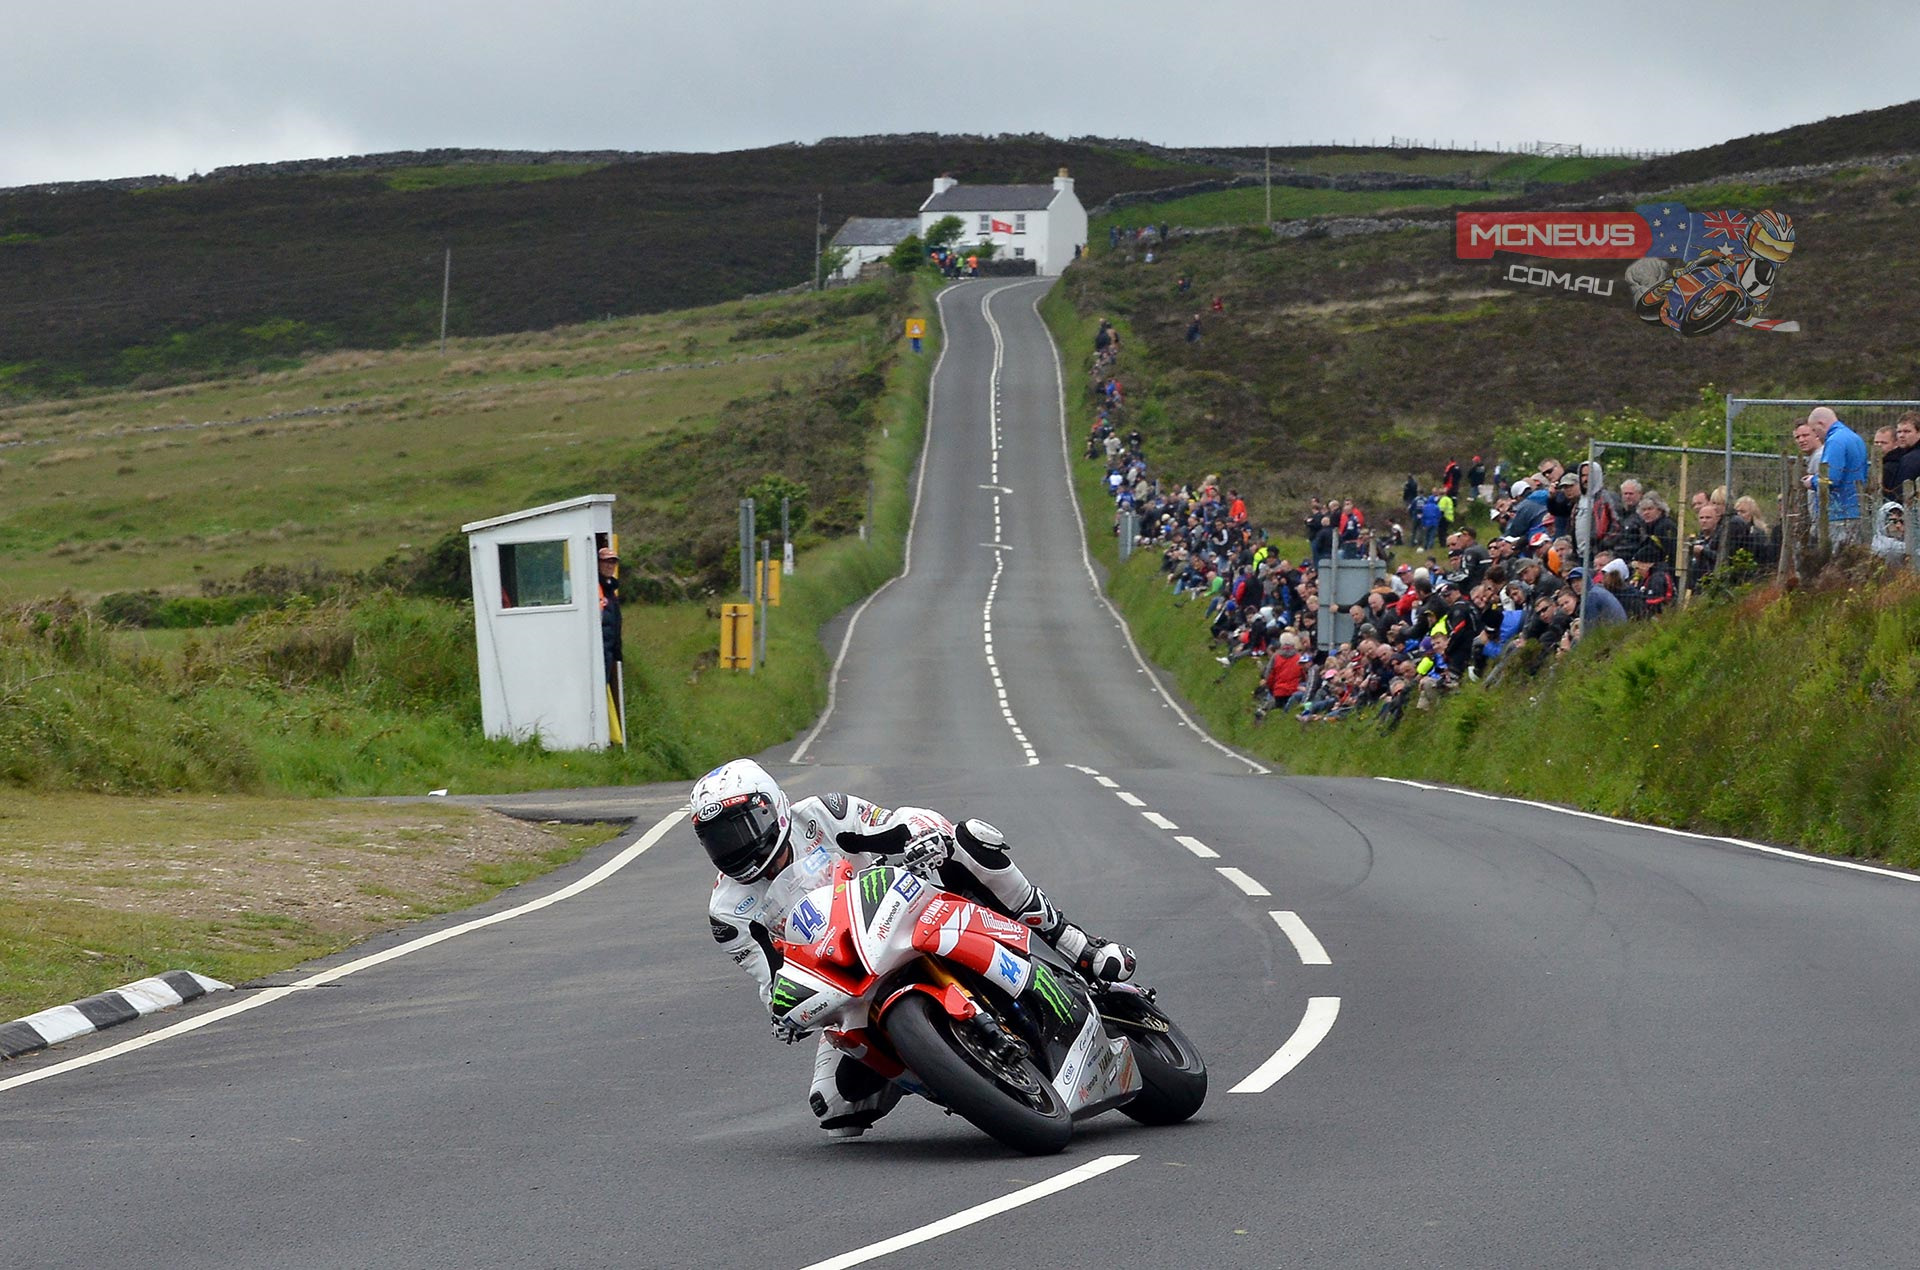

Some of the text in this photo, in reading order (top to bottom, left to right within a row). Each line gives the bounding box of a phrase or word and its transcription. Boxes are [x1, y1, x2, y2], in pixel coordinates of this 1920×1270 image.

[700, 804, 719, 818] Arai
[792, 897, 826, 943] 14
[1000, 951, 1022, 985] 14
